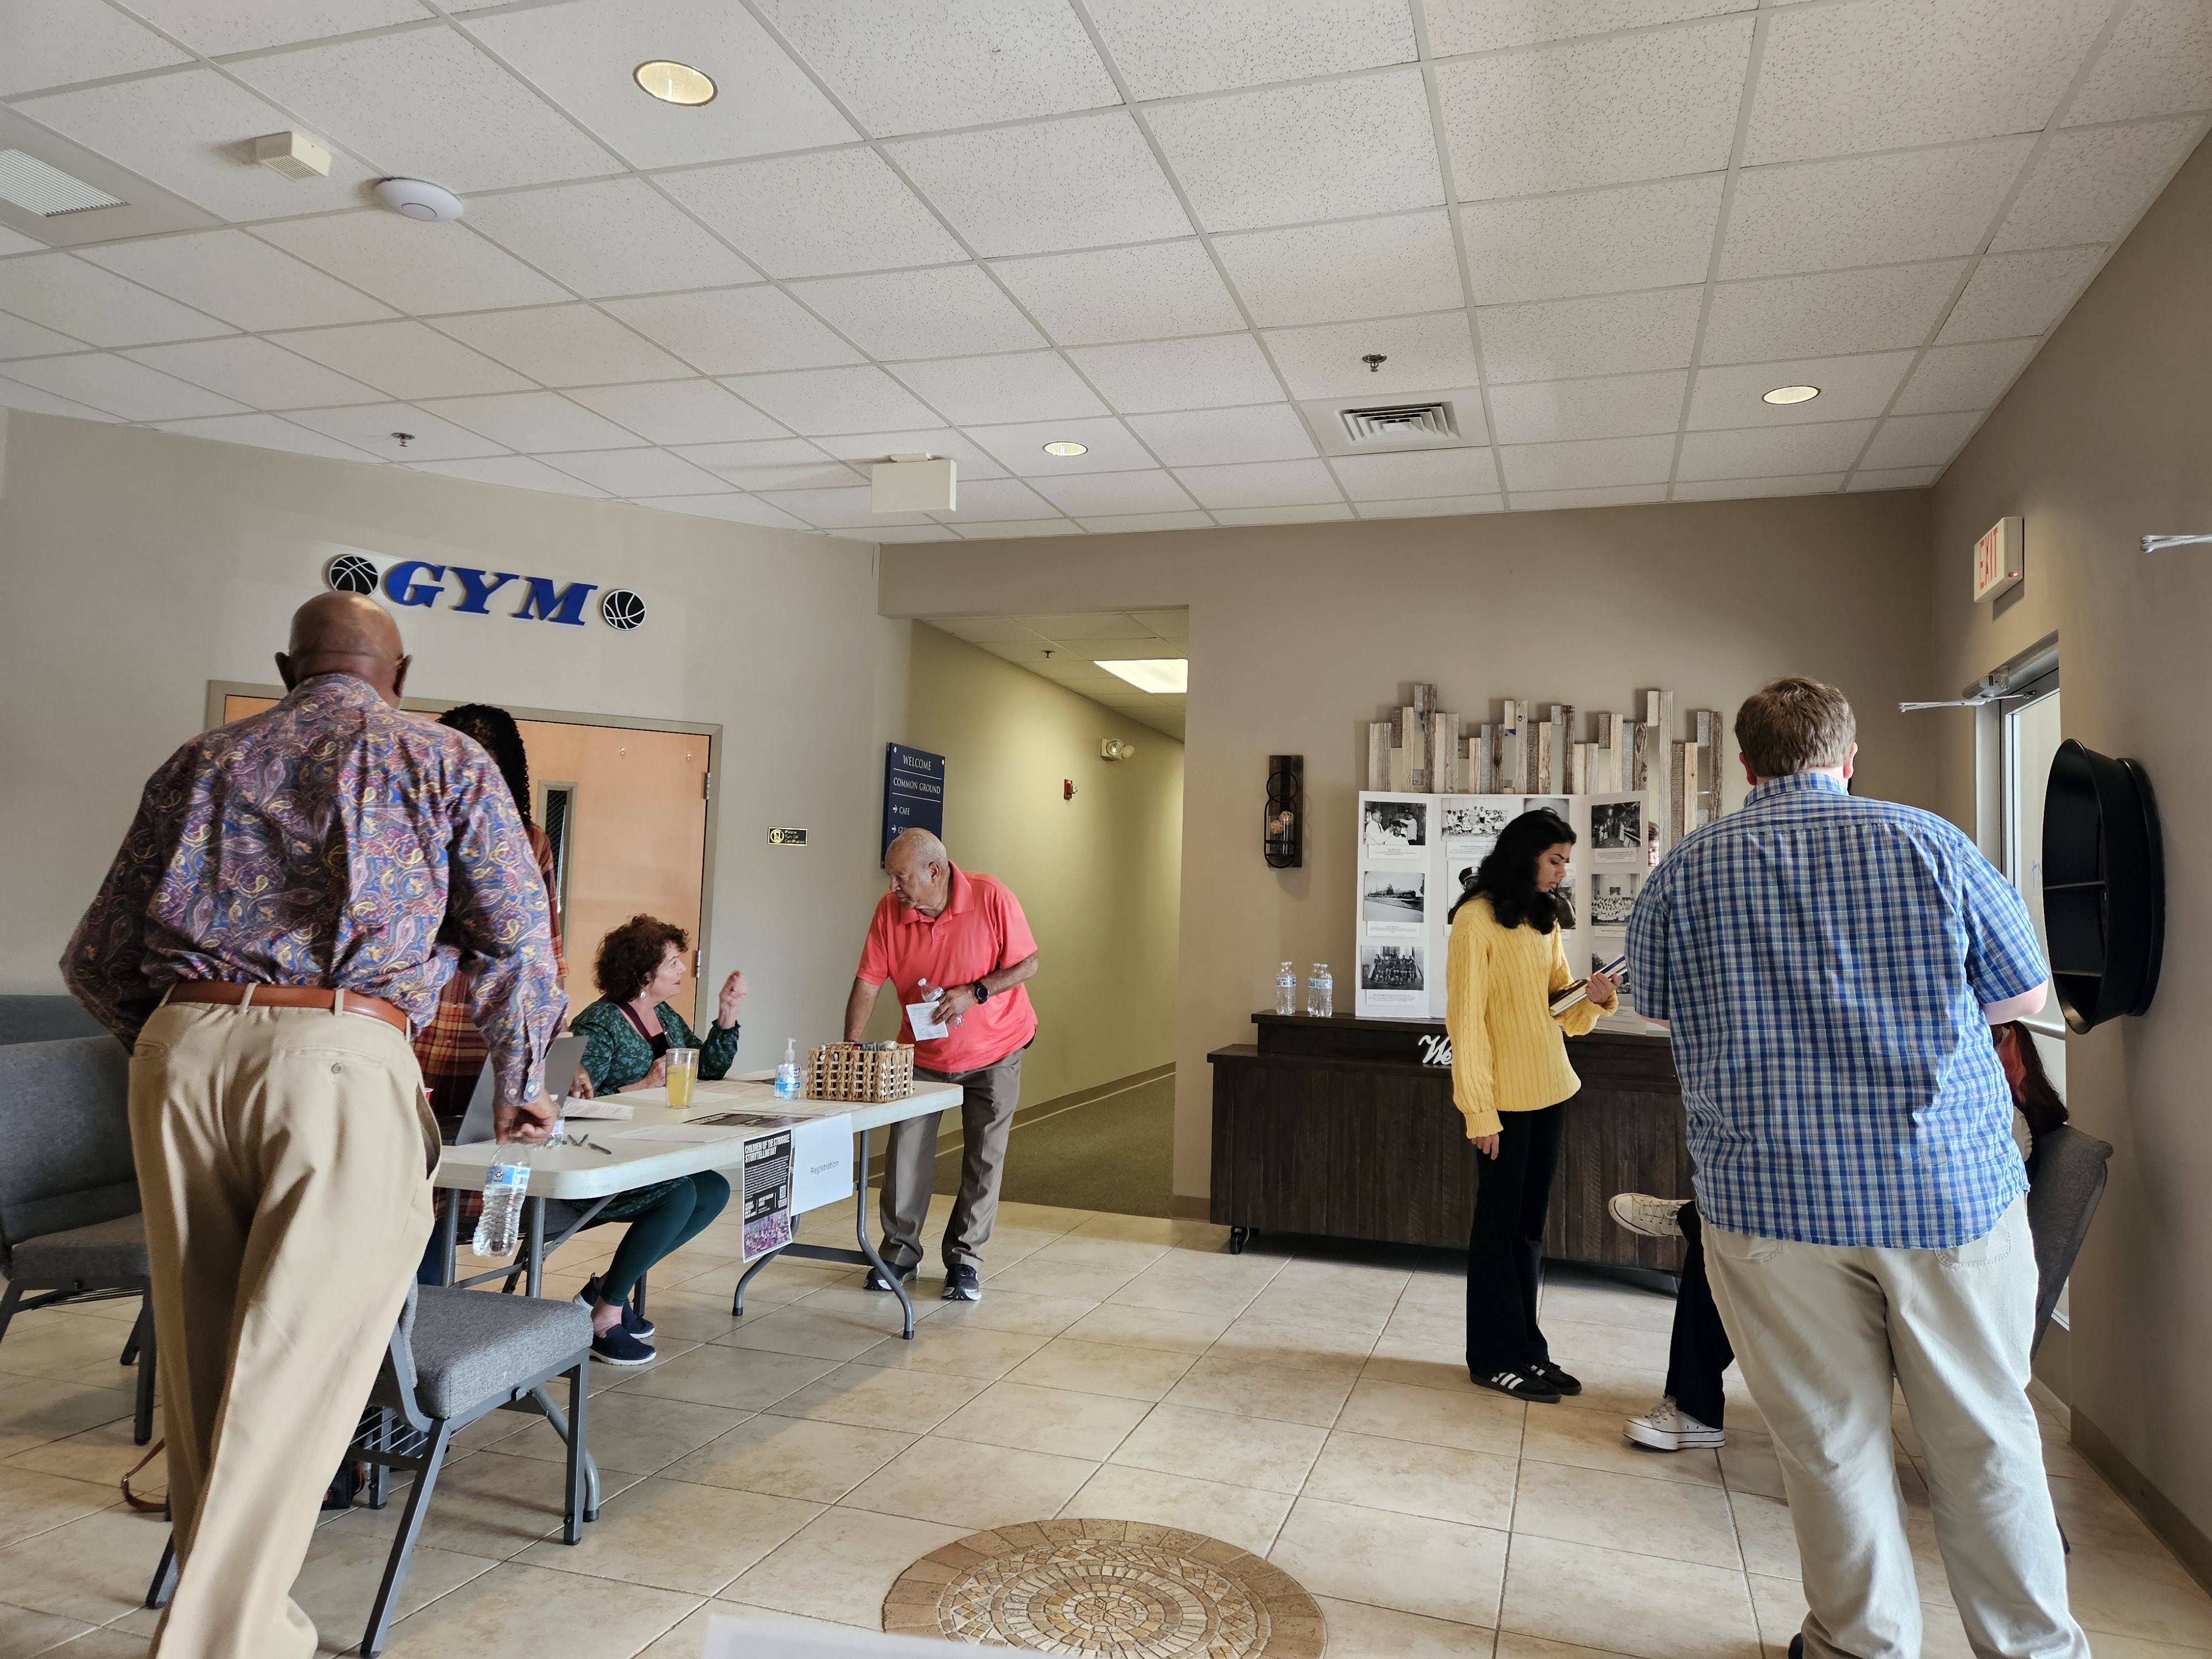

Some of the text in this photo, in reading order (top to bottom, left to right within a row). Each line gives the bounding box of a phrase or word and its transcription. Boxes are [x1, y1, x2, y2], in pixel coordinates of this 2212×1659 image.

[1980, 526, 1998, 590] EXIT
[385, 560, 598, 626] GYM
[902, 754, 931, 770] WELCOME
[893, 777, 941, 795] COMMON GROUND
[899, 806, 910, 815] CAFE
[745, 1141, 762, 1154] CHILDREN
[762, 1140, 768, 1150] OF
[773, 1134, 790, 1146] STRUGGLE
[745, 1147, 770, 1164] STORYTELLING
[810, 1160, 839, 1176] Registration
